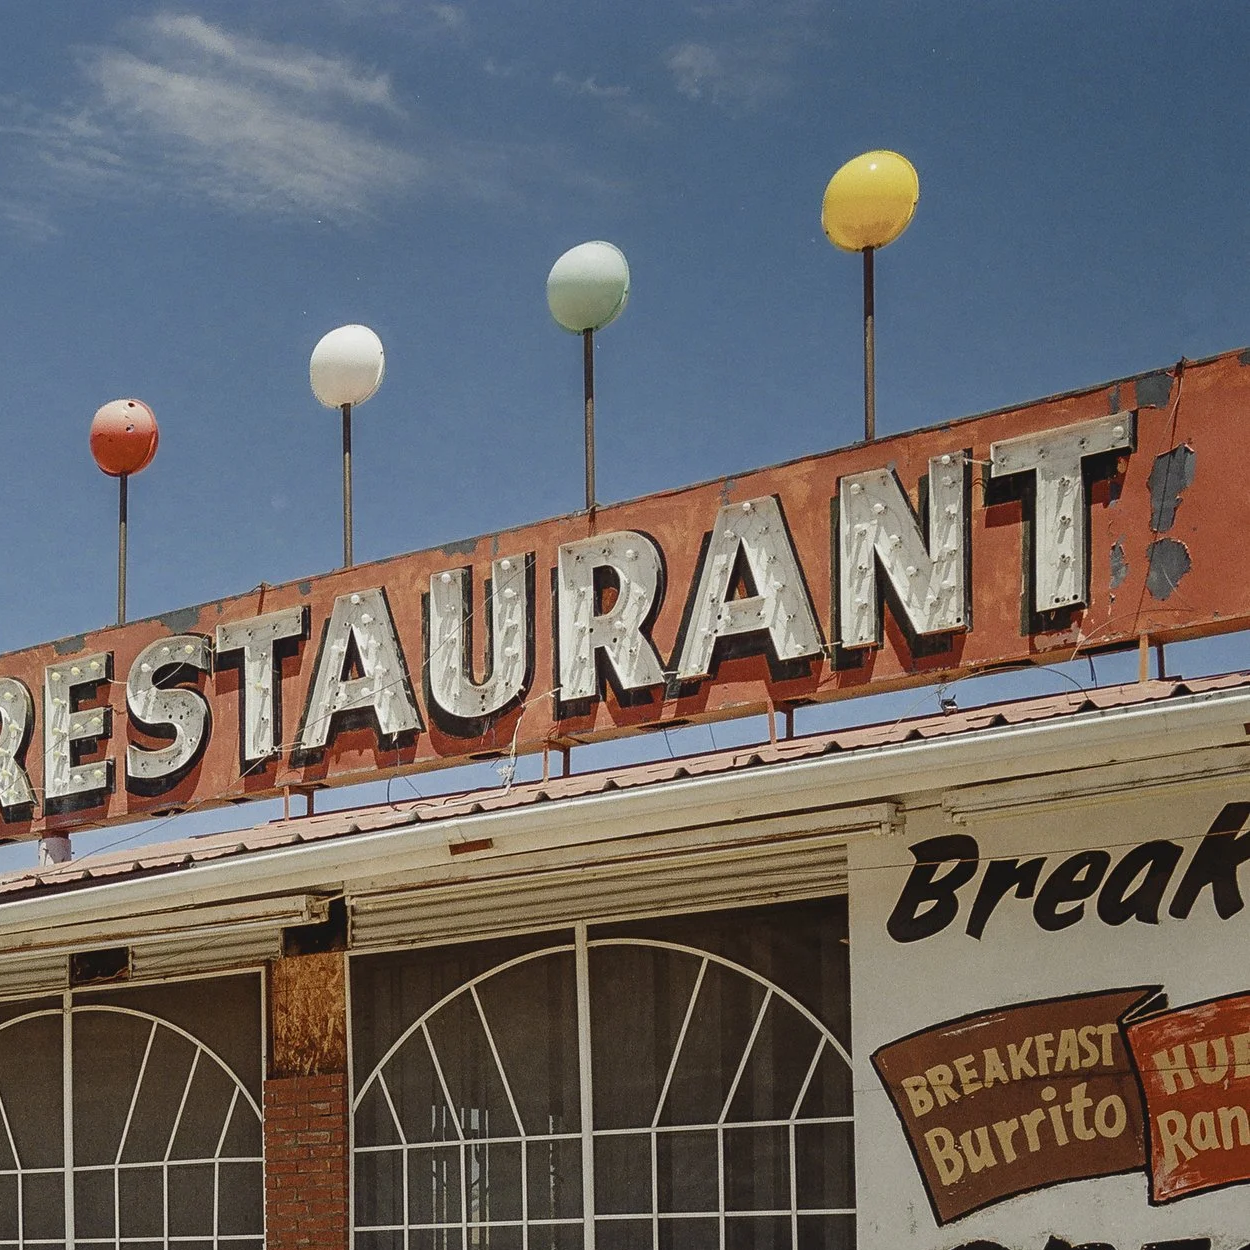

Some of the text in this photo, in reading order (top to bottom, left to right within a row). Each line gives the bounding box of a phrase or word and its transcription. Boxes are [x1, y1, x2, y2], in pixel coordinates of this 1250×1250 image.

[901, 1023, 1120, 1118] BREAKFAST
[924, 1082, 1128, 1186] Burrito
[1156, 1105, 1250, 1176] Ran
